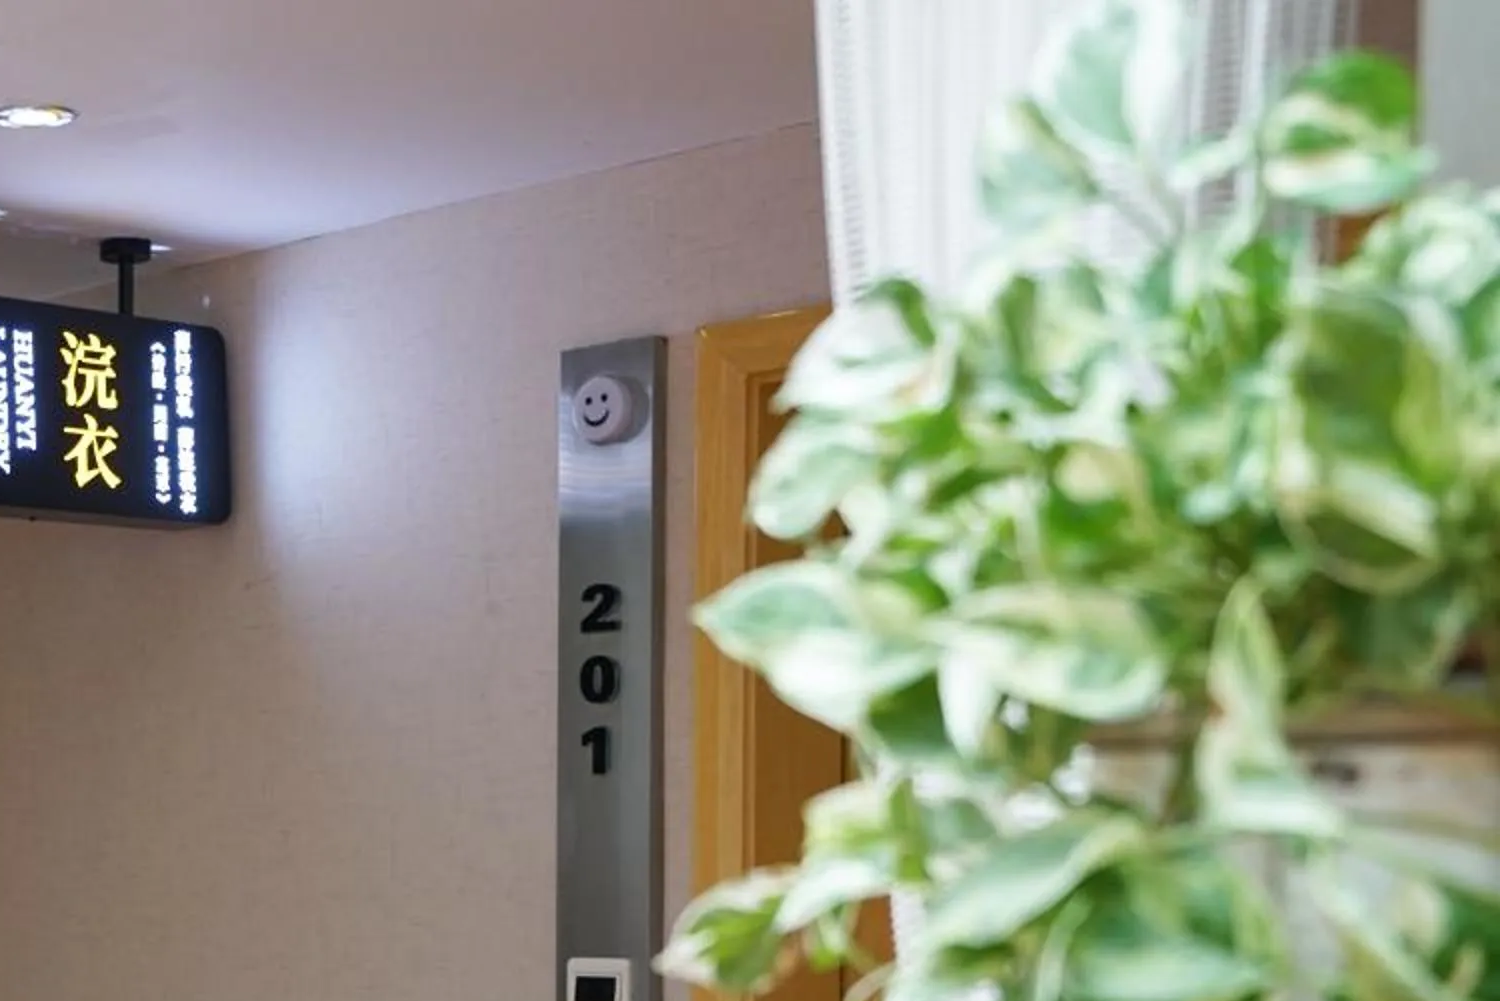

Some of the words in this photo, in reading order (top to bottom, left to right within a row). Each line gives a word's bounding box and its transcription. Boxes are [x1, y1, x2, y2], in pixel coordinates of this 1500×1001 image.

[13, 329, 38, 451] HUANYI
[59, 330, 122, 490] 浣衣
[579, 583, 620, 775] 201
